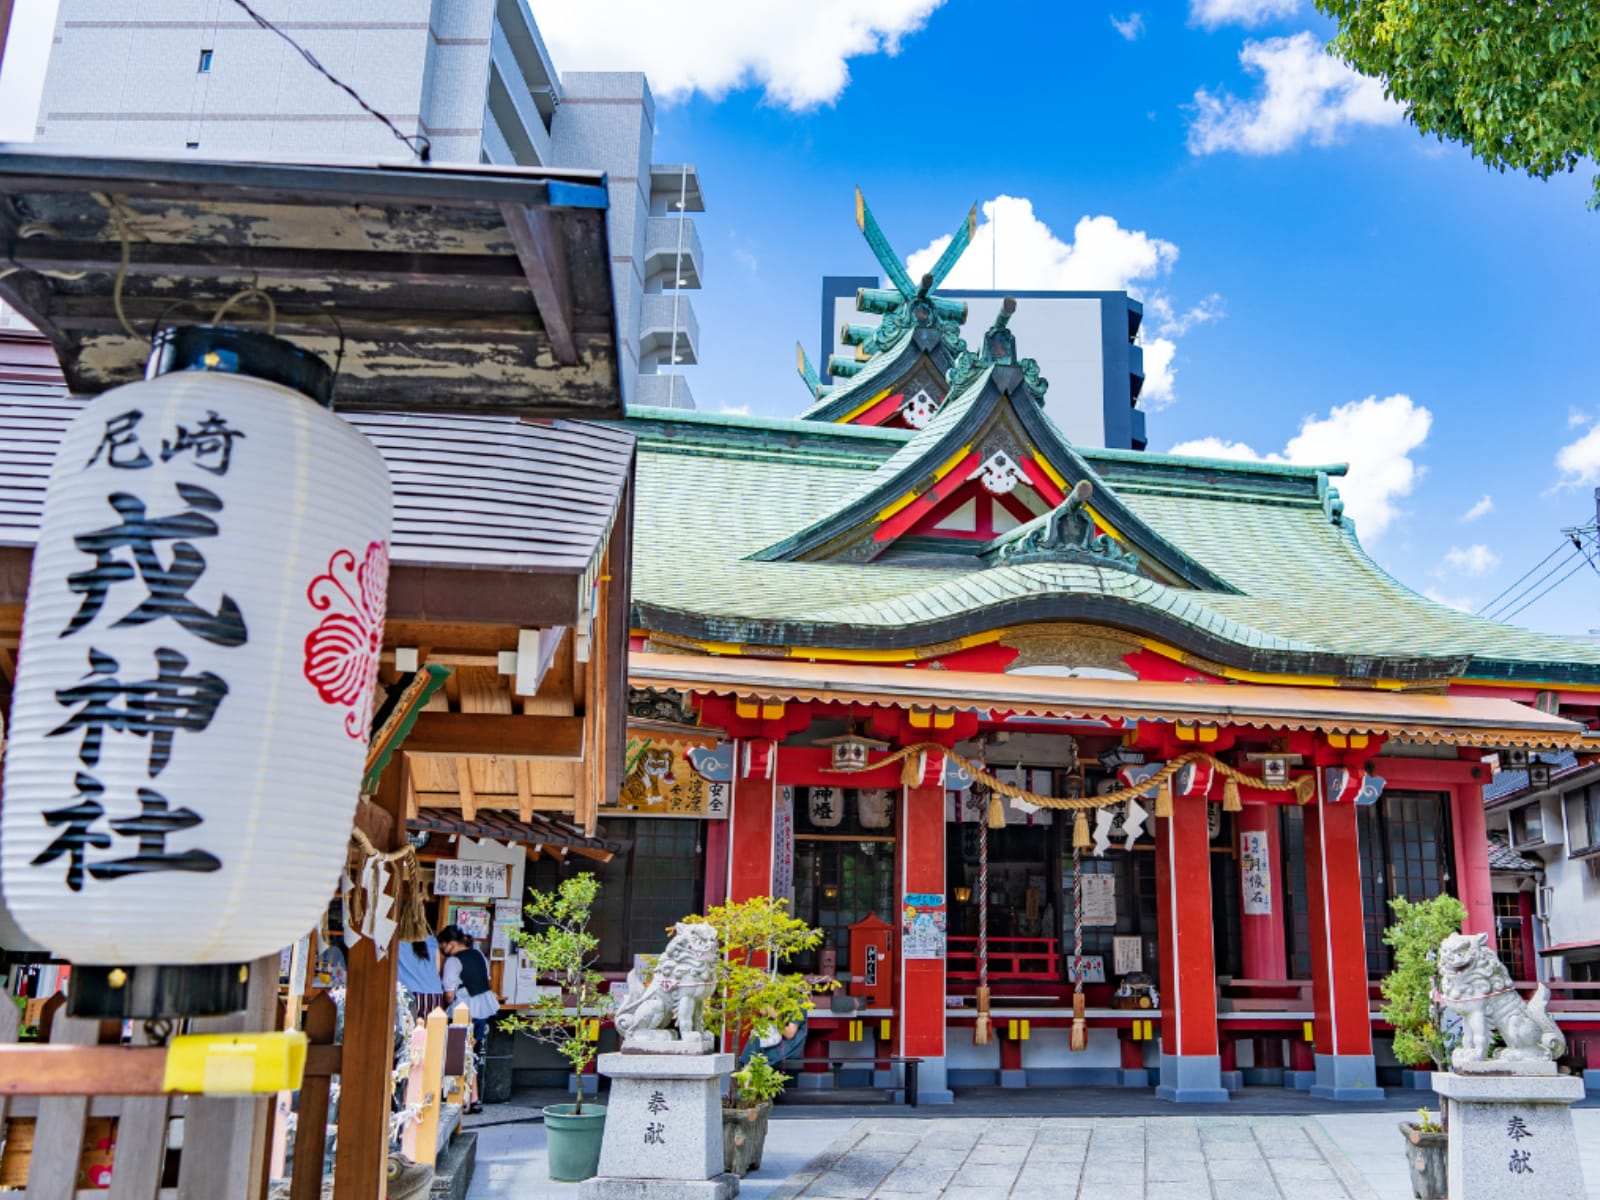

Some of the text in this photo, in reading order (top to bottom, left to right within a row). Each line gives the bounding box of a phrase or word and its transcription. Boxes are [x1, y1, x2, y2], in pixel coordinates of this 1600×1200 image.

[86, 409, 248, 476] 尼崎
[29, 482, 249, 892] 戎神社
[438, 863, 506, 881] 御朱印受付所
[643, 1090, 670, 1146] 奉献
[1506, 1115, 1535, 1175] 奉献
